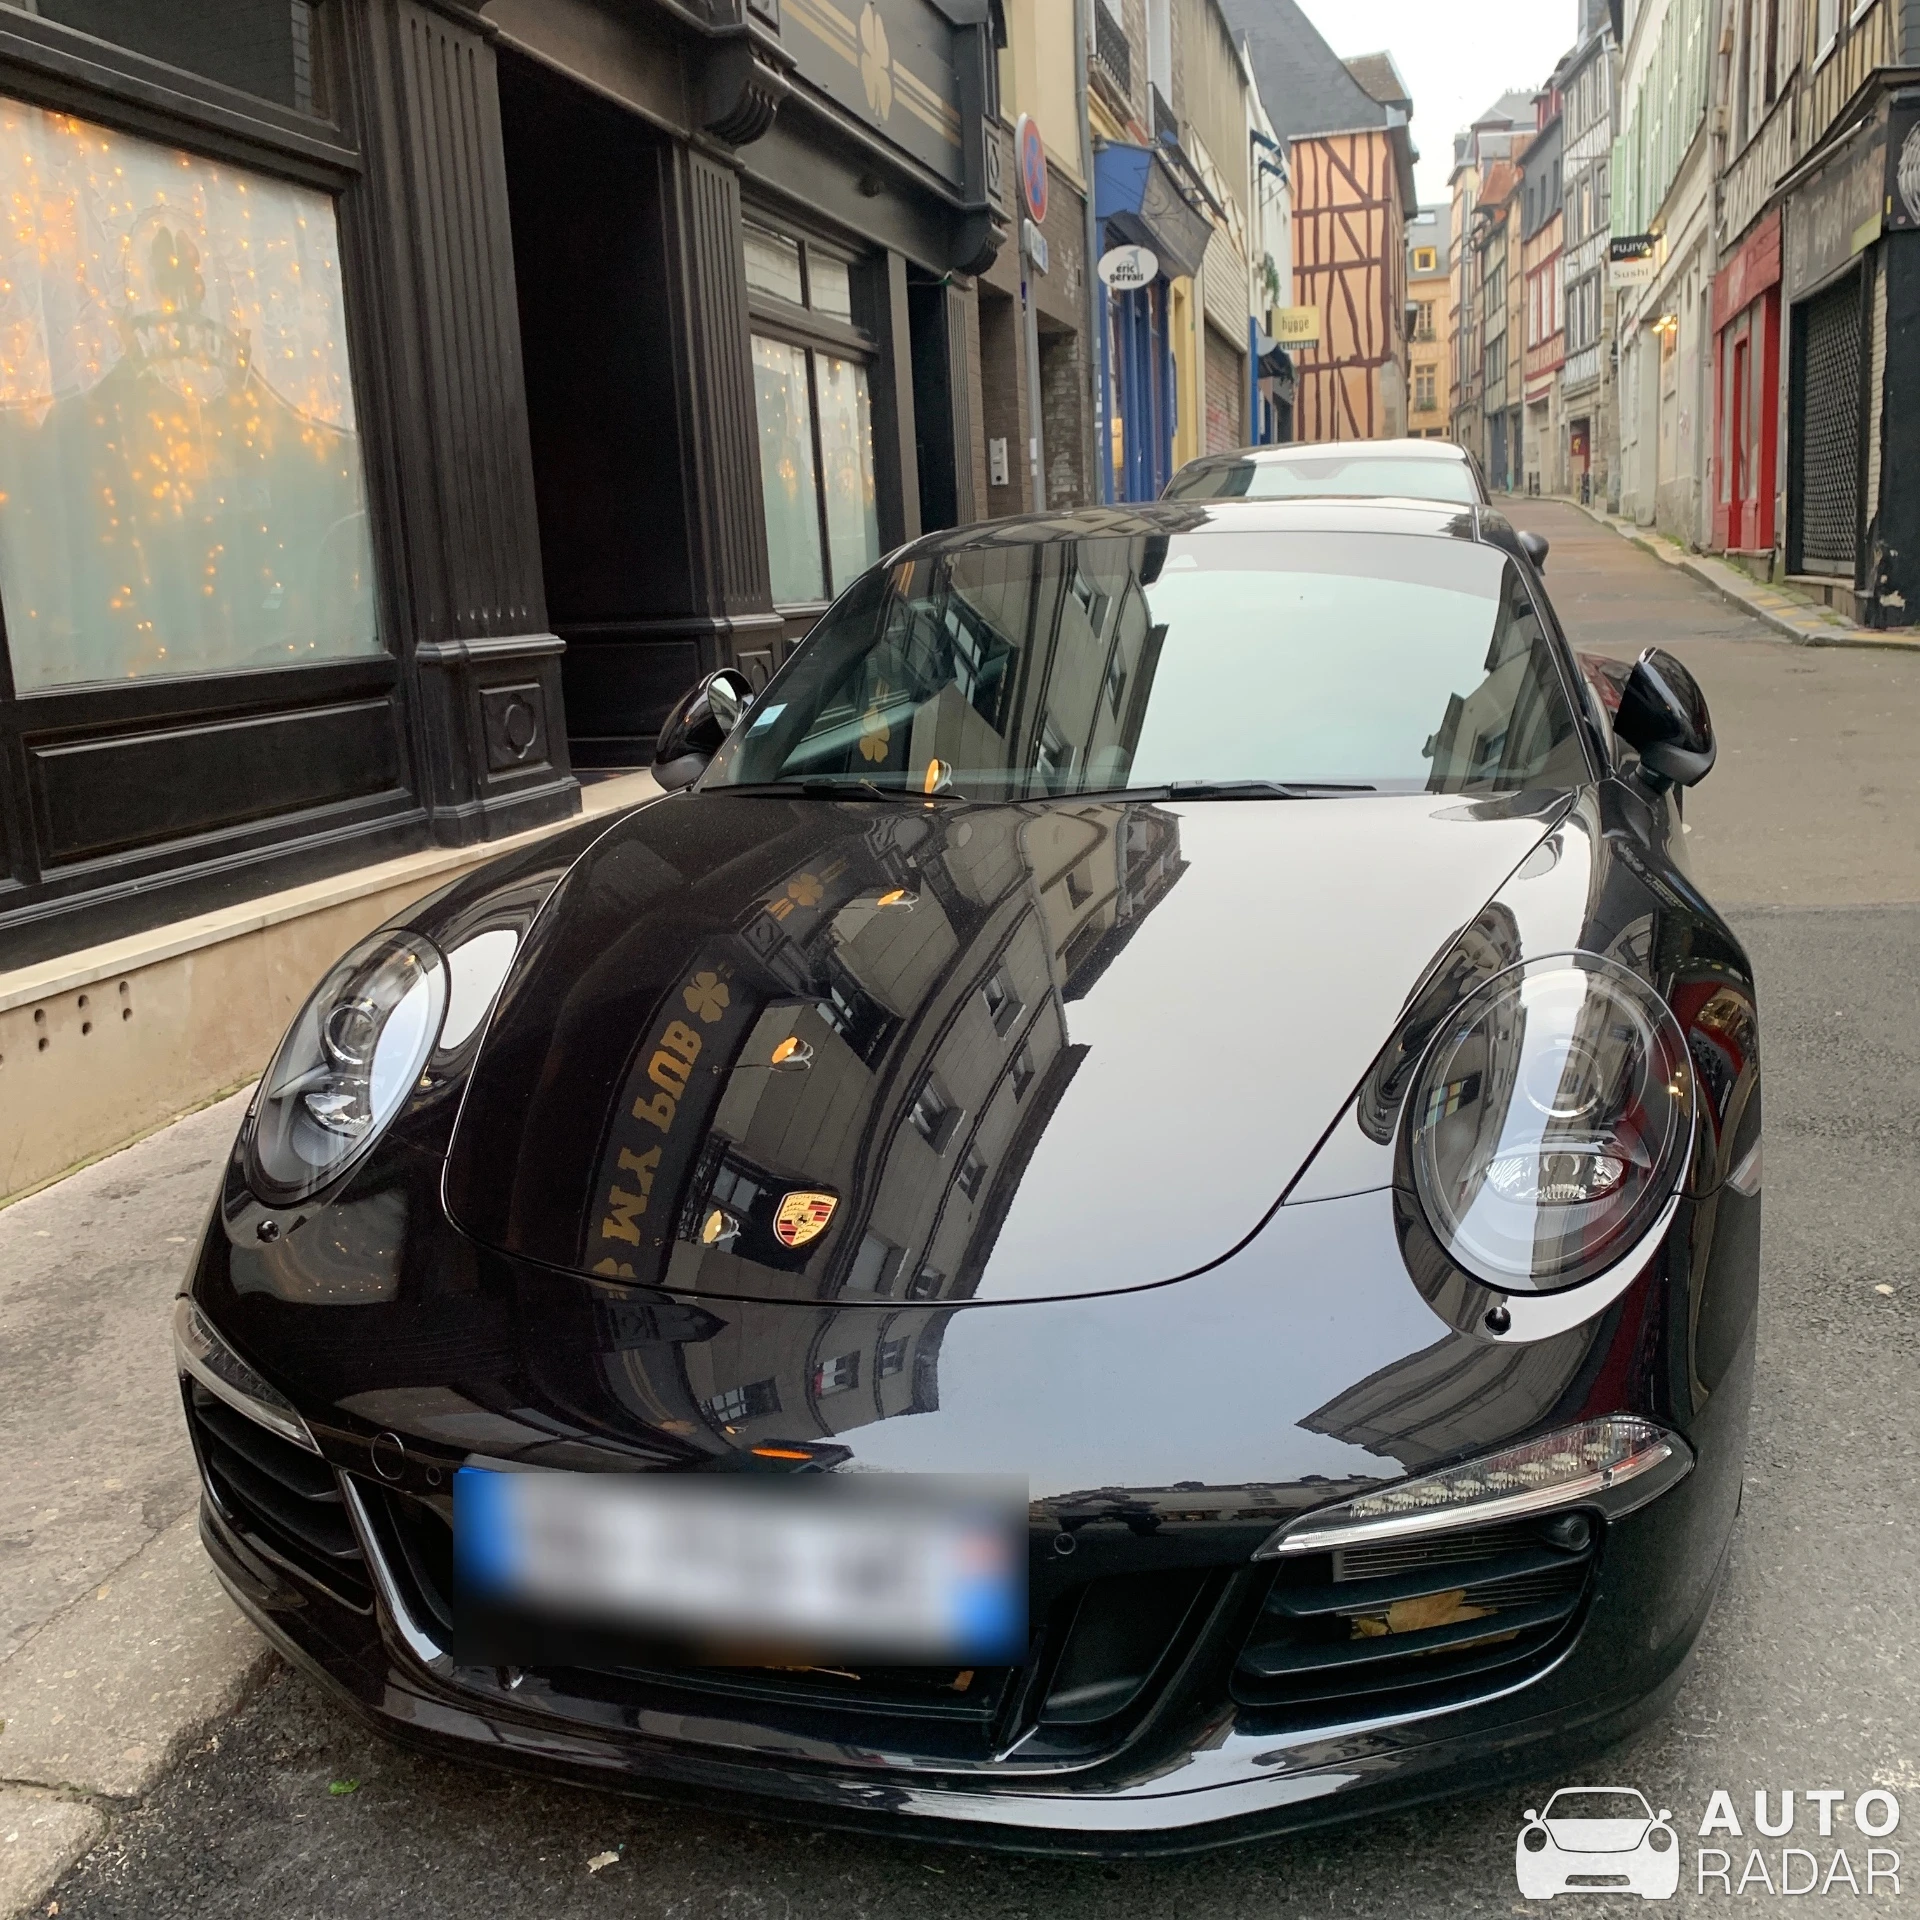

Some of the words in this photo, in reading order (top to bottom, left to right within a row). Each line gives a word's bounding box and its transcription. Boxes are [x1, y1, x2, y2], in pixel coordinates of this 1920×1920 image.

[1612, 241, 1649, 254] FUJIYA
[1116, 264, 1135, 274] eric
[1614, 268, 1649, 278] Sushi
[1109, 273, 1144, 284] gervais
